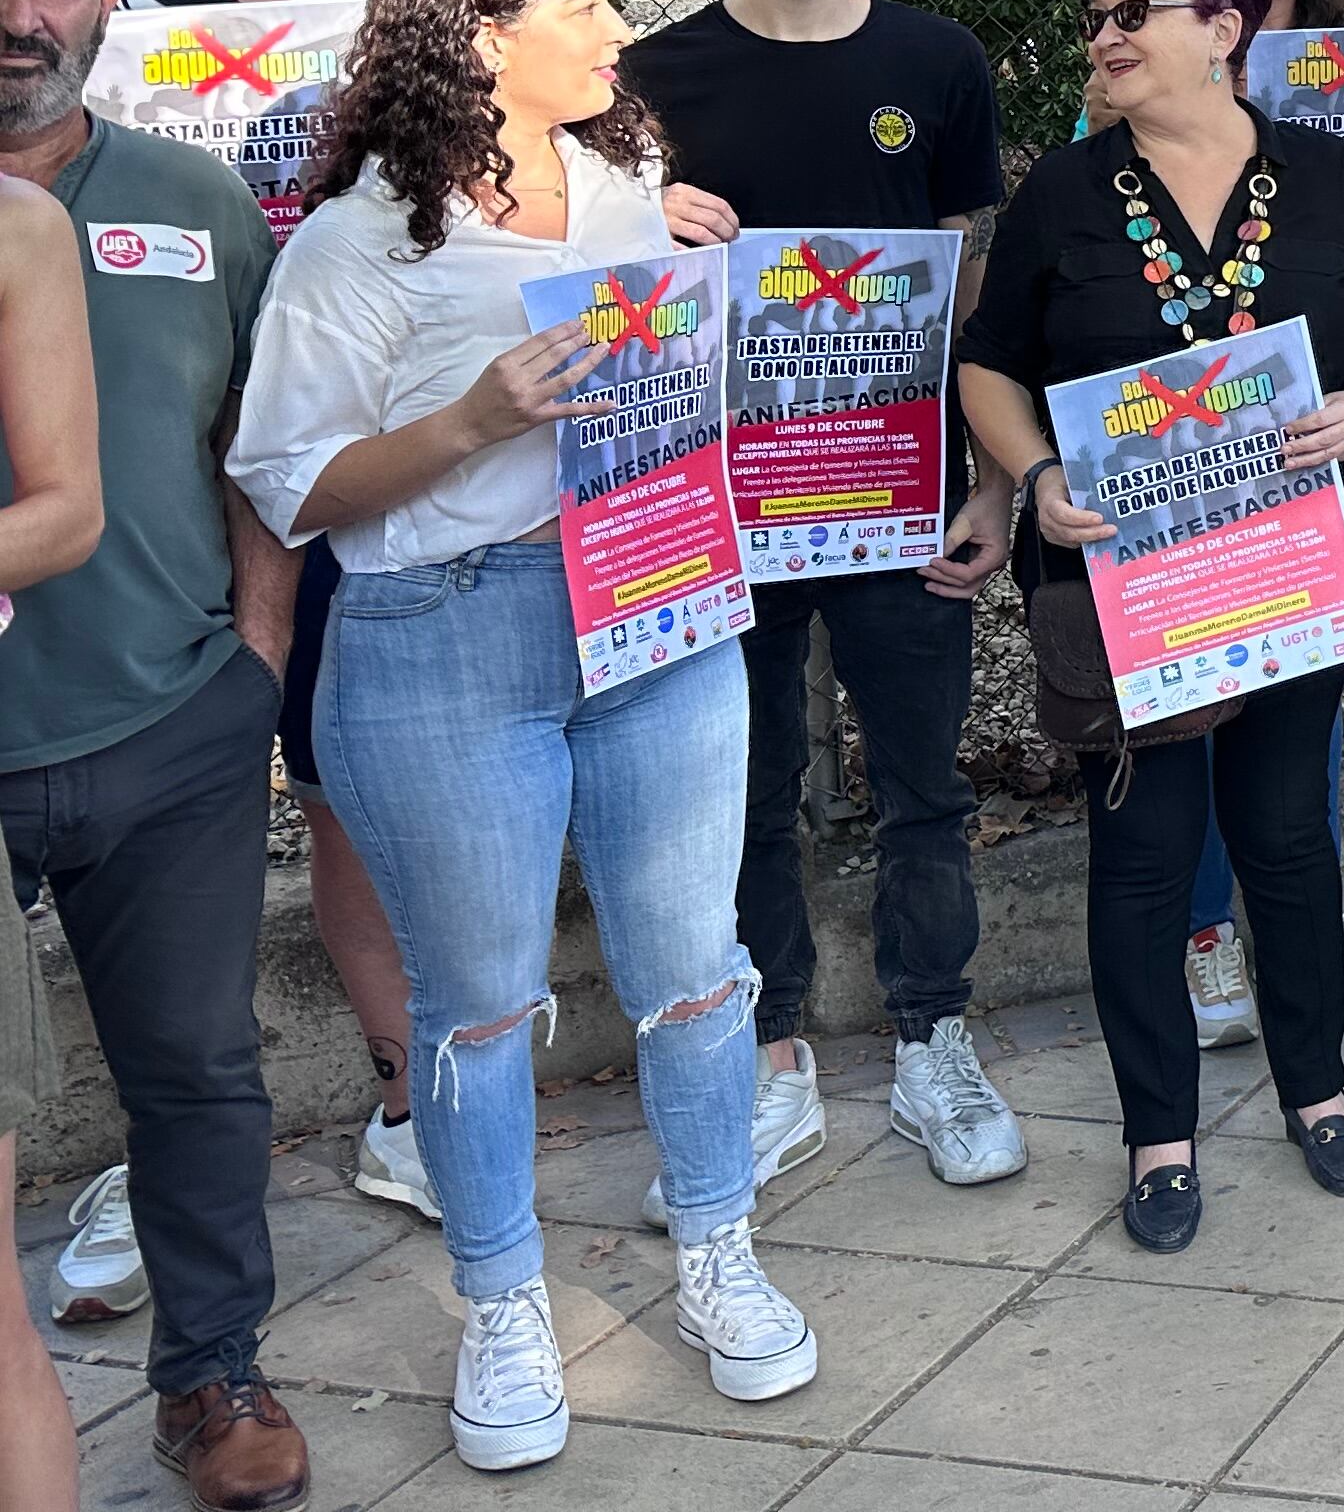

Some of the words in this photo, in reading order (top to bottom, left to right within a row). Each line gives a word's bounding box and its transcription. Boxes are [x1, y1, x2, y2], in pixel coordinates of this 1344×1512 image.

[210, 120, 239, 140] DE
[102, 235, 140, 251] UGT
[738, 337, 803, 359] ¡BASTA
[806, 336, 827, 354] DE
[832, 332, 901, 353] RETENER
[906, 331, 924, 351] EL
[749, 359, 798, 380] BONO
[803, 358, 824, 378] DE
[828, 355, 912, 378] ALQUILER!
[618, 381, 636, 407] DE
[638, 369, 693, 403] RETENER
[696, 364, 710, 389] EL
[580, 416, 614, 447] BONO
[618, 409, 634, 435] DE
[775, 425, 806, 435] LUNES
[808, 424, 815, 433] 9
[817, 422, 832, 432] DE
[834, 419, 884, 431] OCTUBRE
[1099, 463, 1170, 500] ¡BASTA
[1171, 455, 1197, 476] DE
[1200, 430, 1278, 469] RETENER
[1116, 487, 1171, 518] BONO
[1174, 479, 1197, 500] DE
[857, 527, 883, 538] UGT
[1161, 548, 1195, 563] LUNES
[1197, 544, 1205, 554] 9
[1207, 537, 1224, 550] DE
[1226, 520, 1281, 546] OCTUBRE
[1125, 570, 1168, 589] HORARIO
[1214, 553, 1231, 564] LAS
[1124, 600, 1155, 616] LUGAR
[1281, 629, 1309, 647] UGT
